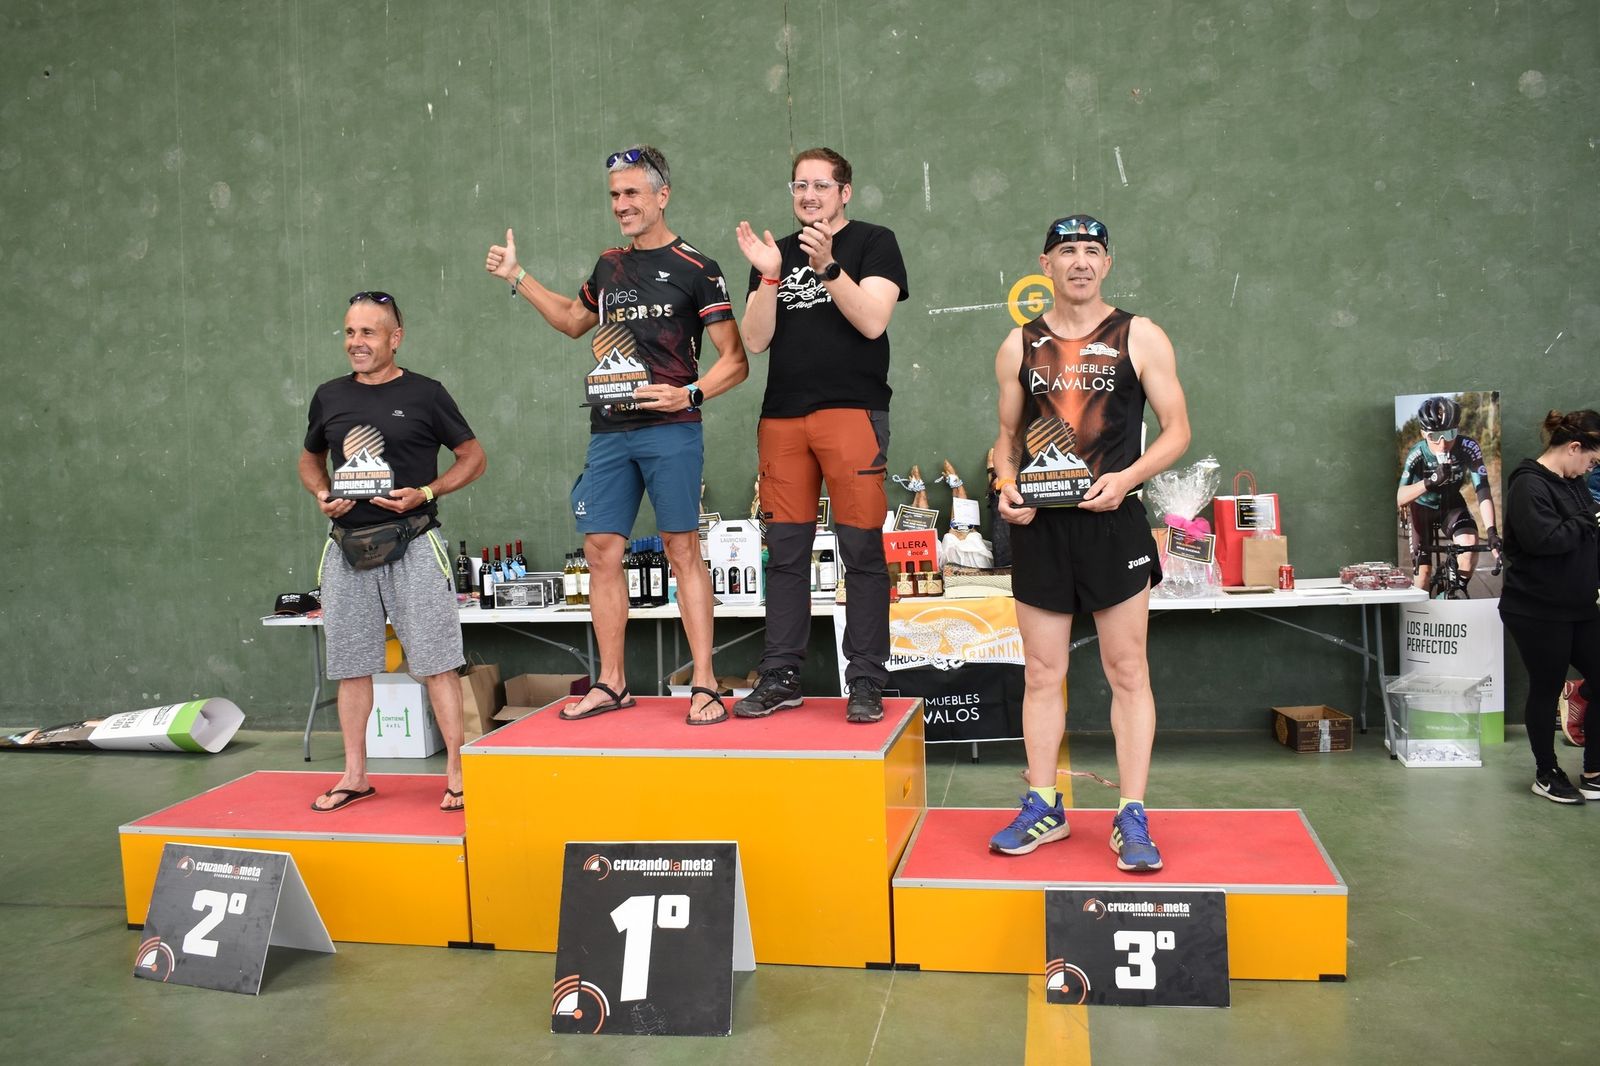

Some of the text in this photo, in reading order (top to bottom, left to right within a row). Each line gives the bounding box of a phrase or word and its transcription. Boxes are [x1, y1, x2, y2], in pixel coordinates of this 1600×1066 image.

[605, 288, 638, 306] pies
[1027, 291, 1045, 313] 5
[606, 304, 674, 322] NEGROS
[1065, 364, 1116, 376] MUEBLES
[588, 383, 633, 395] ABRUCENA
[1051, 373, 1115, 392] ÁVALOS
[1046, 469, 1089, 480] MILENARIA
[1020, 480, 1071, 494] ABRUCENA
[890, 540, 928, 551] YLLERA
[1406, 620, 1468, 638] LOS ALIADOS
[970, 641, 1025, 659] RUNNIN
[1406, 637, 1458, 655] PERFECTOS
[925, 693, 981, 707] MUEBLES
[923, 707, 981, 725] VALOS
[195, 861, 262, 877] cruzandolameta
[613, 857, 715, 871] cruzandolameta
[1107, 901, 1191, 913] cruzandolameta
[182, 888, 248, 958] 2º
[609, 894, 691, 1003] 1º
[1113, 930, 1176, 990] 3º
